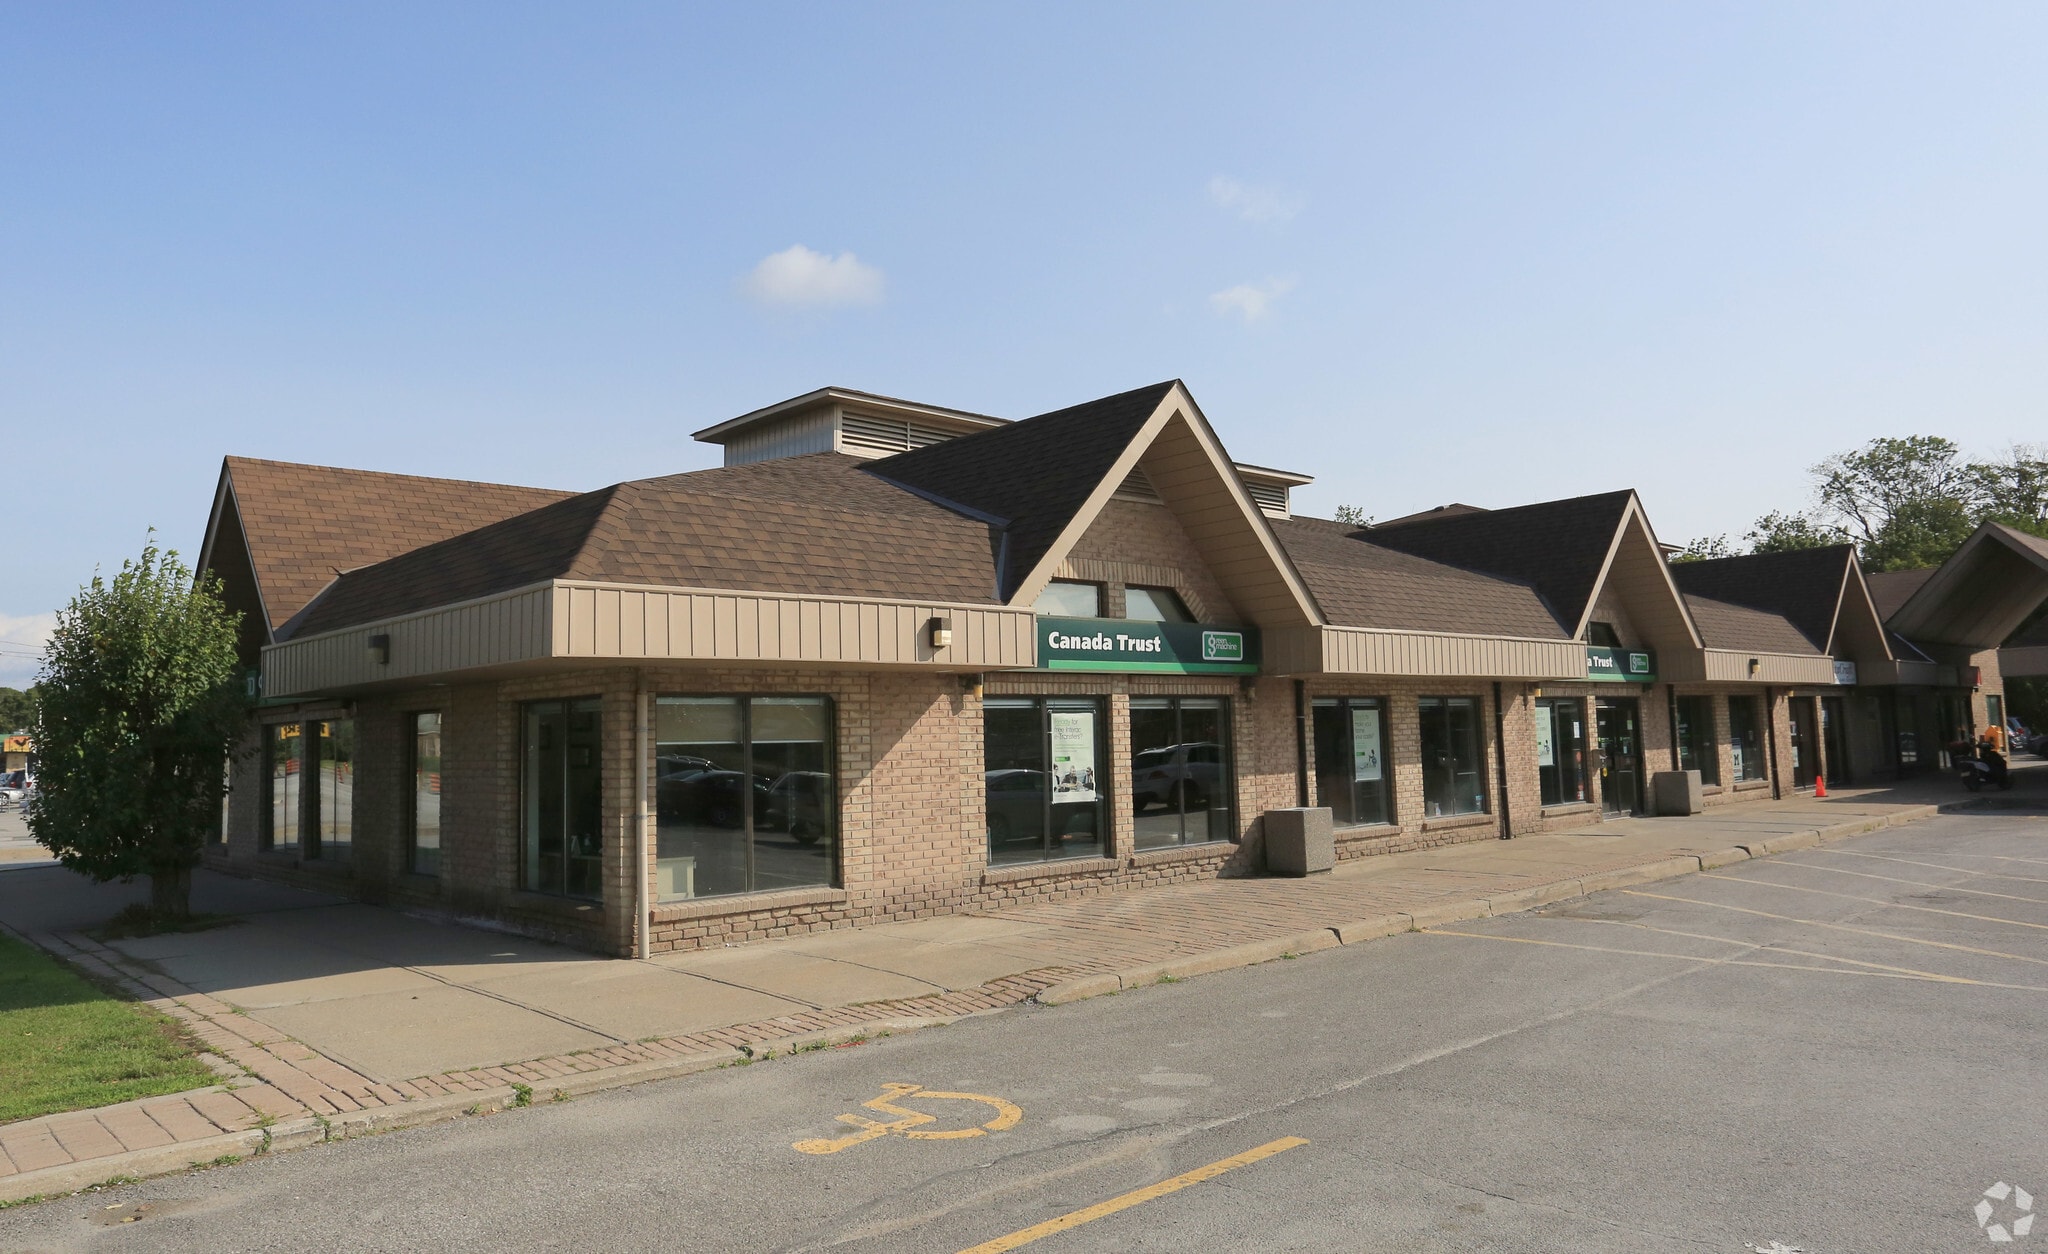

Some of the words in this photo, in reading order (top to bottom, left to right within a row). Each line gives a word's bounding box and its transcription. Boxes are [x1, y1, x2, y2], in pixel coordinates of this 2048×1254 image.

[1048, 631, 1112, 651] Canada
[1116, 634, 1161, 653] Trust
[1593, 655, 1613, 668] Trust
